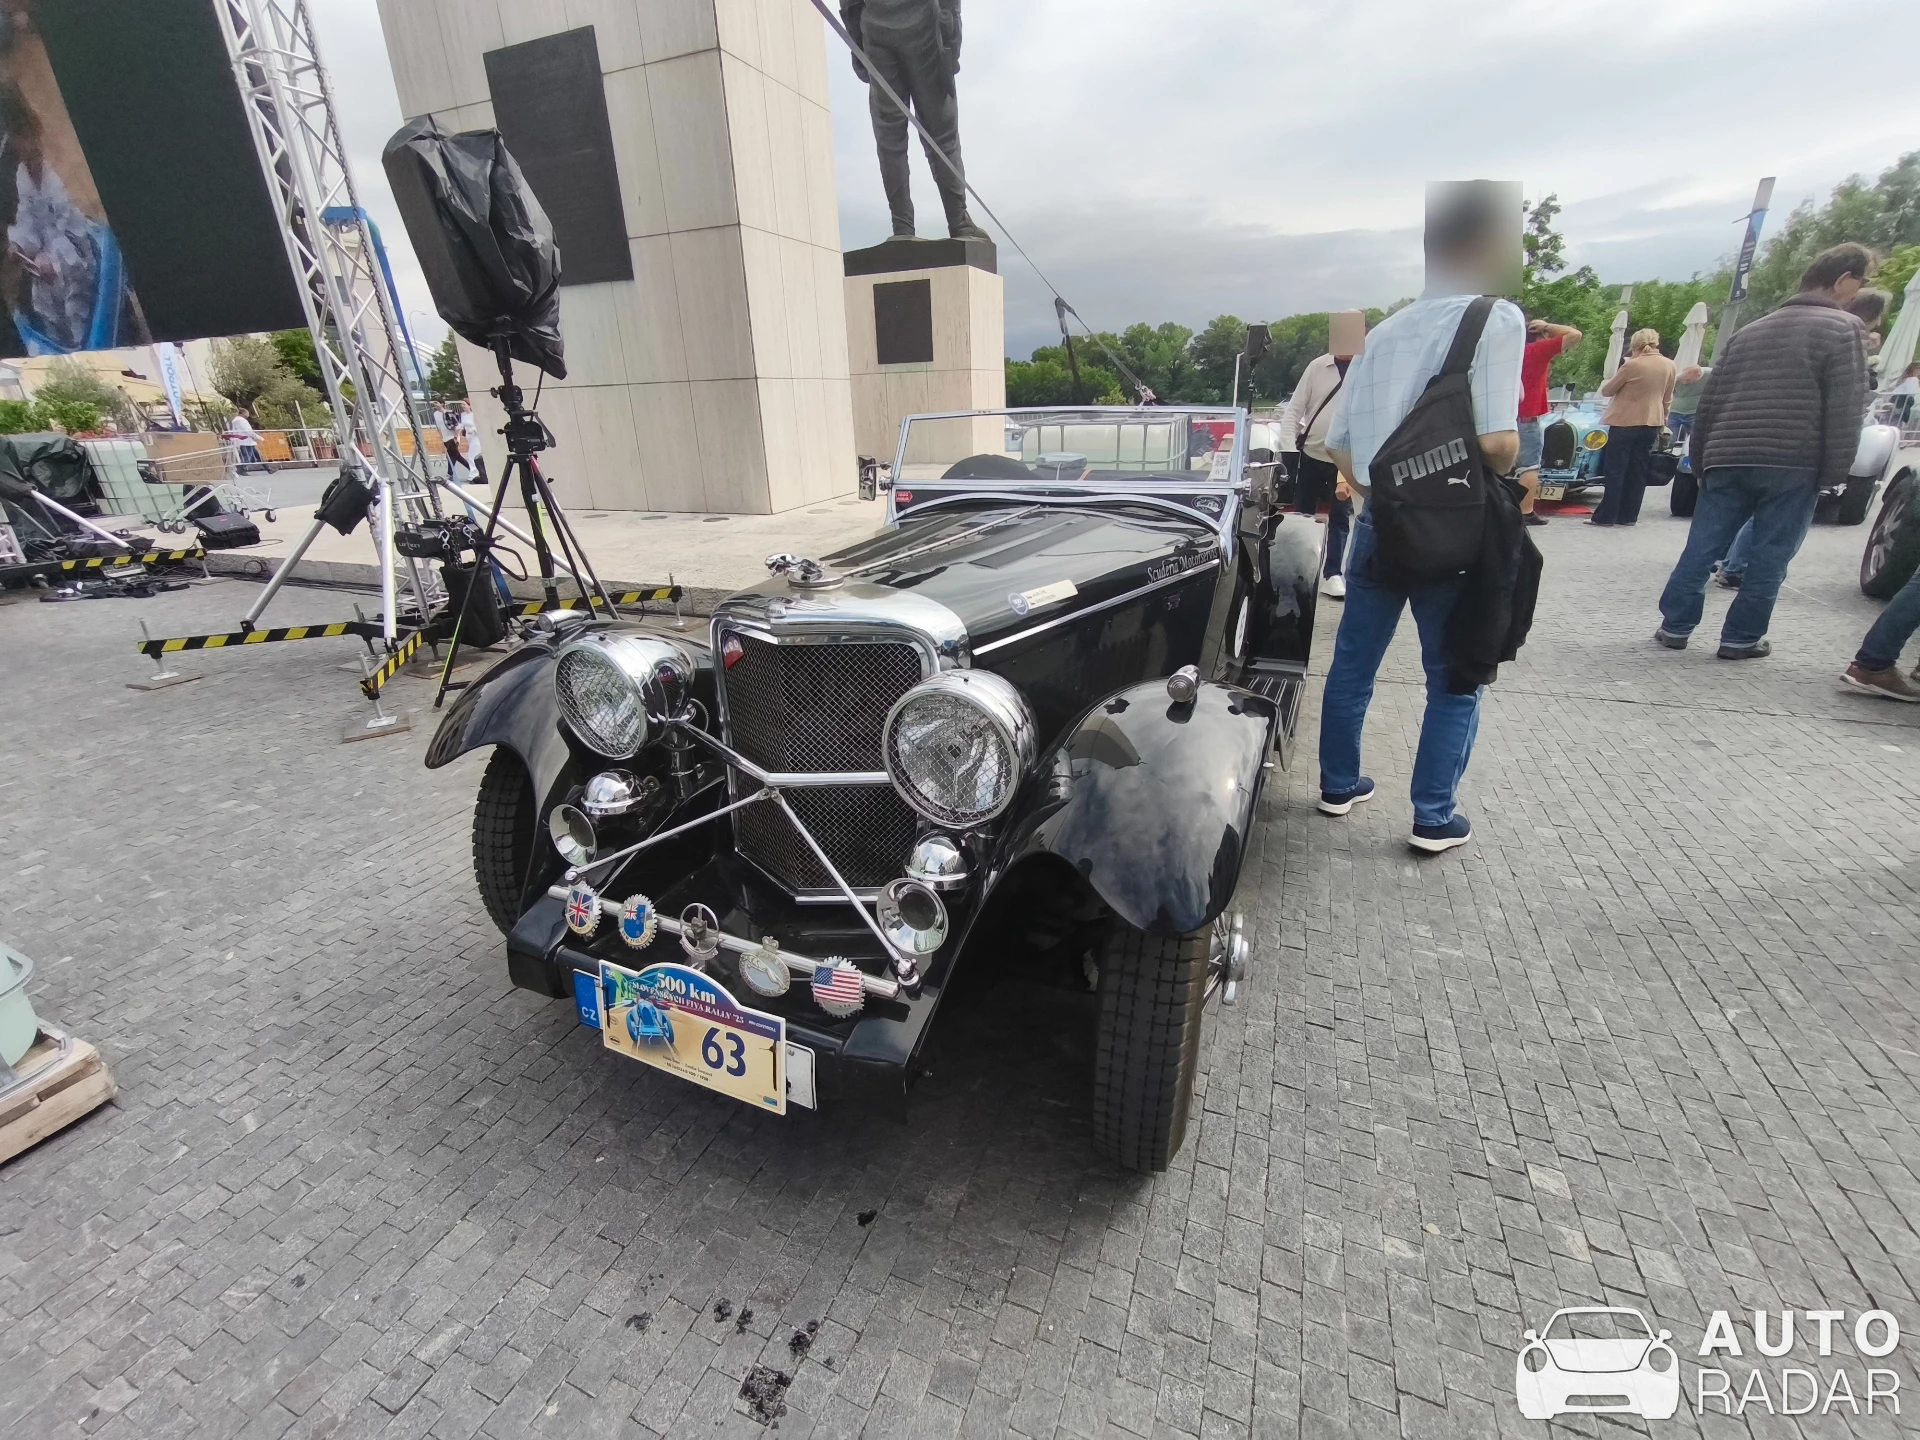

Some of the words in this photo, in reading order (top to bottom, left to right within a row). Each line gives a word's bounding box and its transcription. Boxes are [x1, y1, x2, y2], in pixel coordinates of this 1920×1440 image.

[1391, 437, 1469, 487] PUMA
[1147, 560, 1179, 584] Scuderia
[1179, 548, 1218, 571] Motorservis
[657, 972, 686, 995] 500
[690, 983, 716, 1004] km
[581, 1006, 597, 1021] CZ
[702, 1027, 746, 1077] 63
